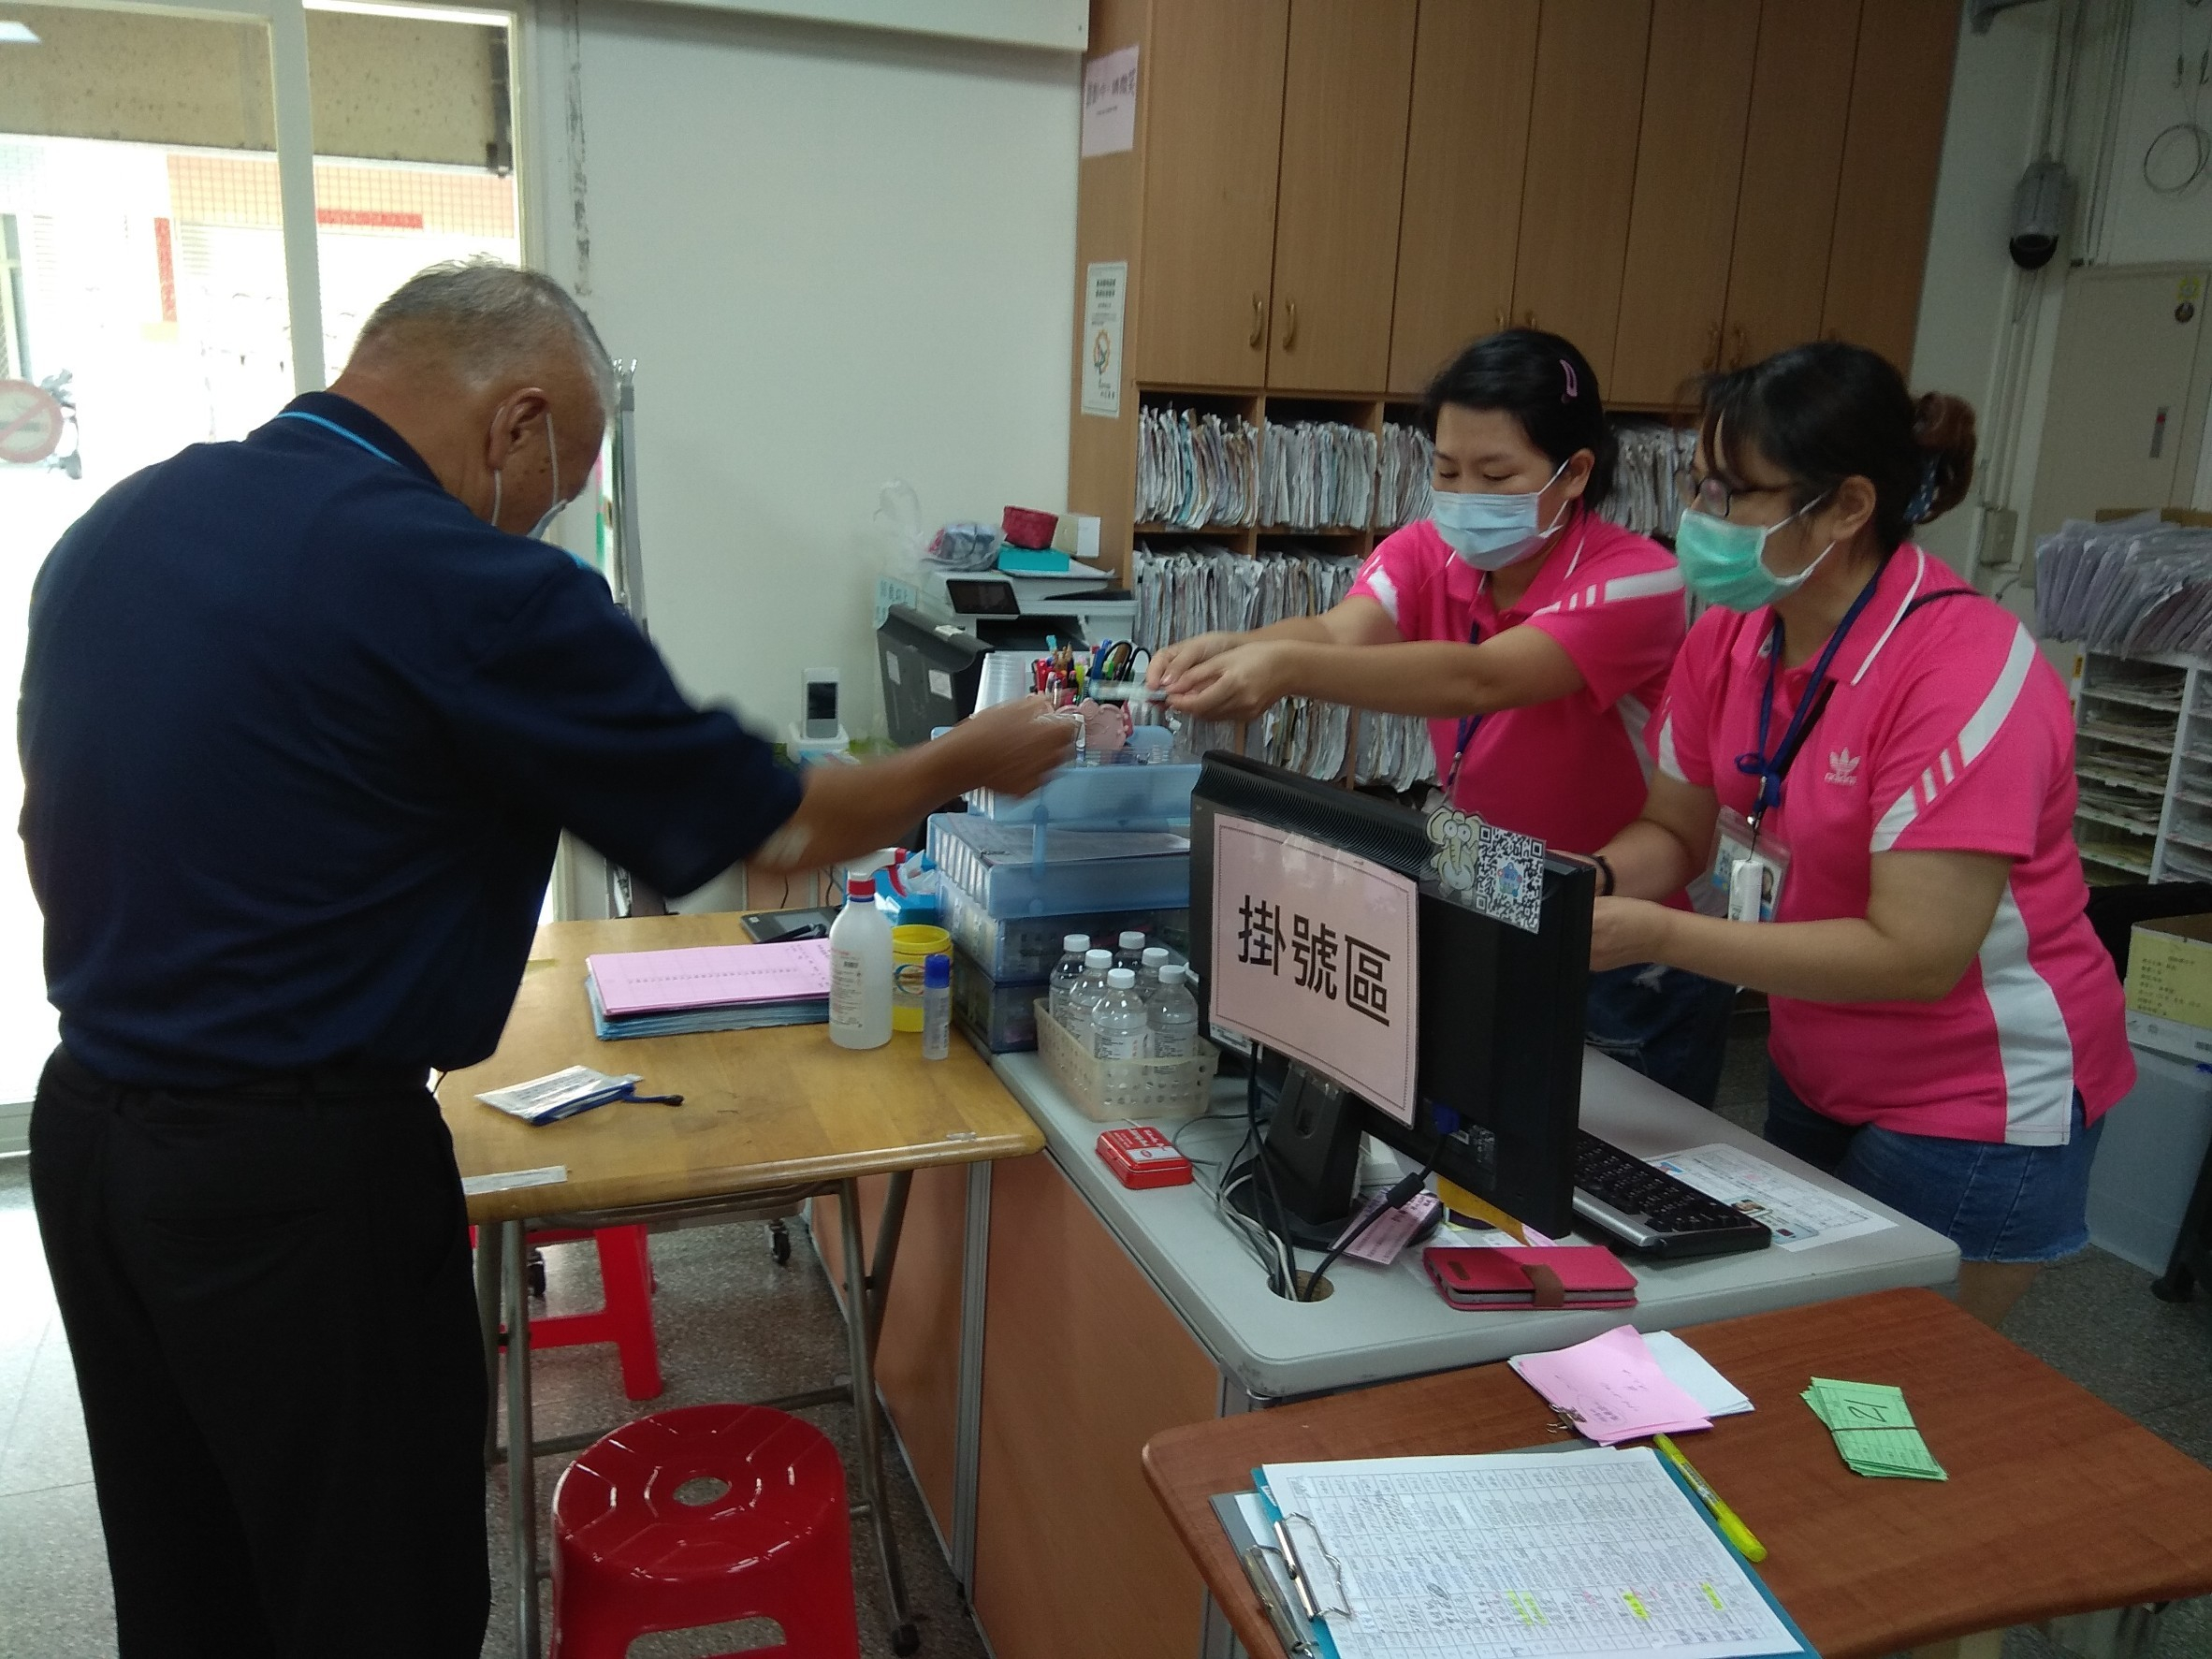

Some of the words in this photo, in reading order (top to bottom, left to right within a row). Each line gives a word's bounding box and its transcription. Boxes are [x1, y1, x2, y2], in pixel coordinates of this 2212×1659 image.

[1238, 895, 1391, 1027] 掛號區
[1843, 1399, 1888, 1422] 21
